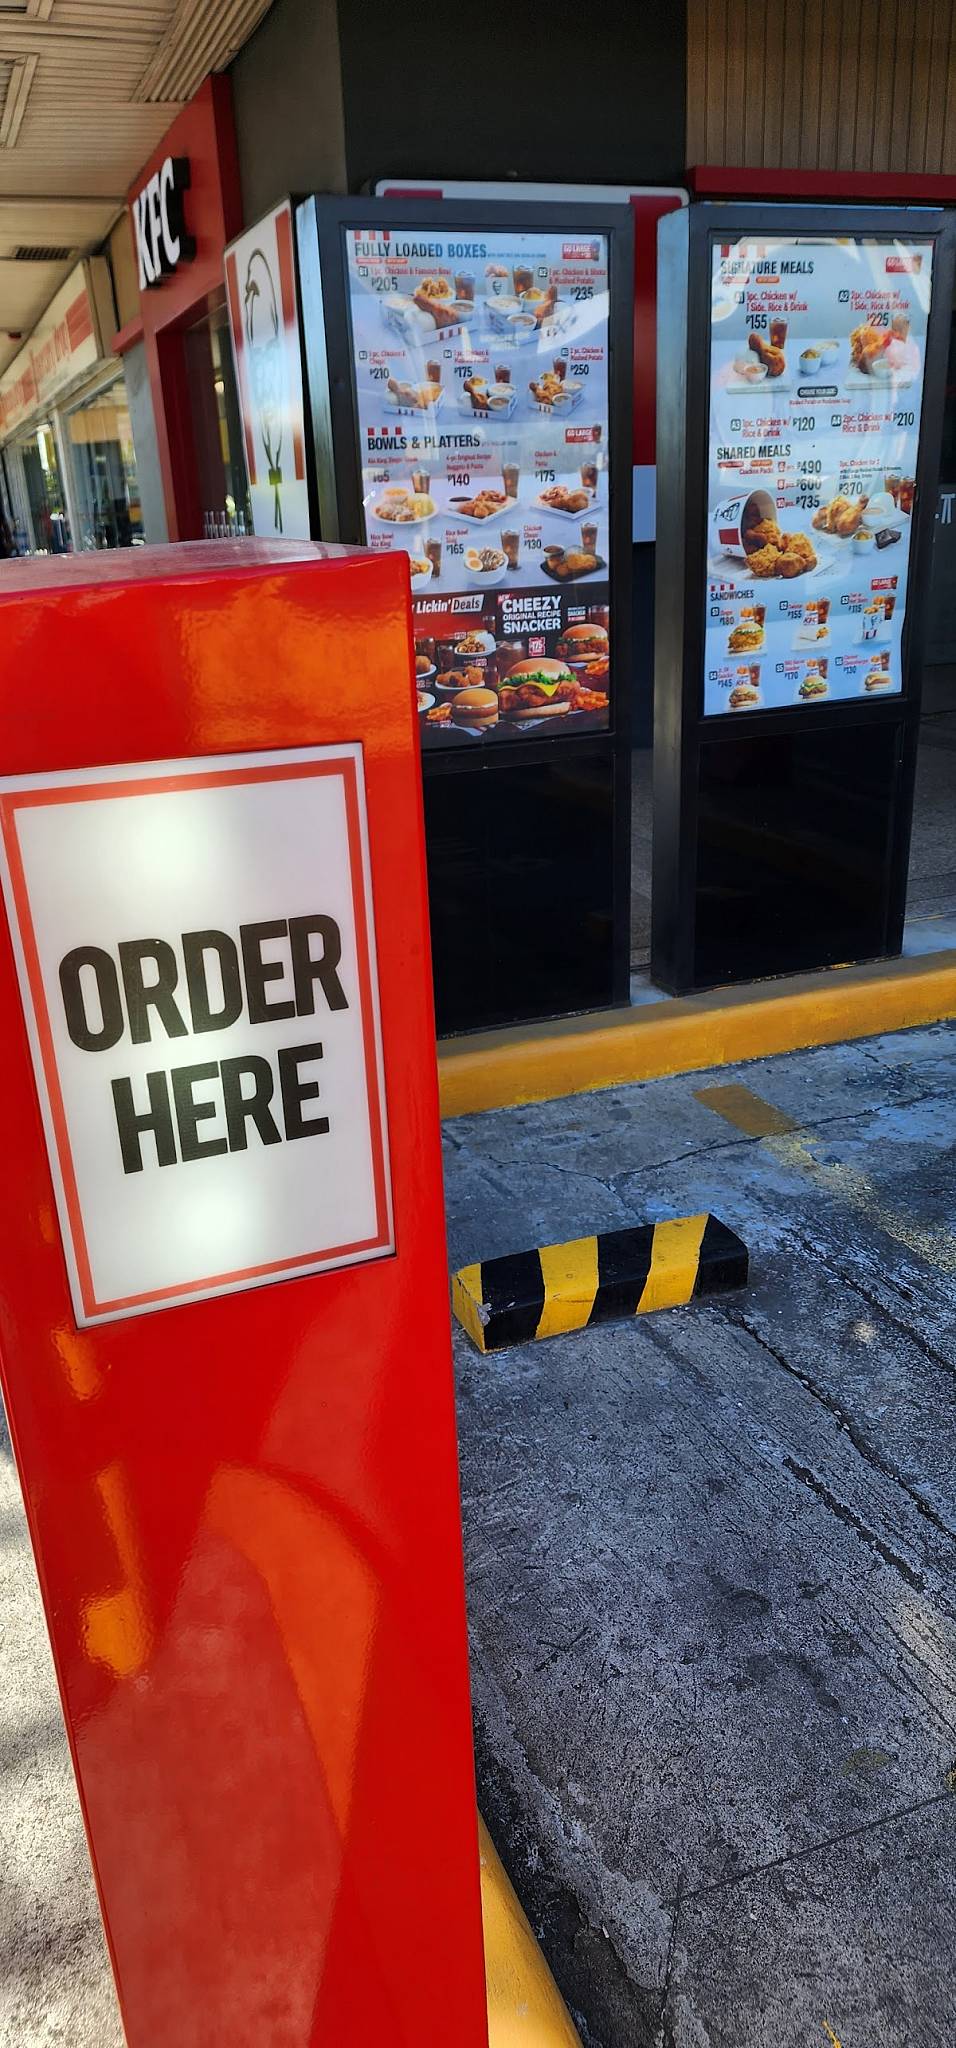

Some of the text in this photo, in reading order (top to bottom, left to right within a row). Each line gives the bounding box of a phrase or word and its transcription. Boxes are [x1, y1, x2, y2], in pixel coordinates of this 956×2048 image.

[133, 156, 181, 291] KFC
[355, 242, 486, 258] FULLY LOADED BOXES
[781, 261, 814, 274] MEALS
[761, 290, 787, 300] Chicken
[768, 301, 781, 311] Rice
[790, 301, 808, 311] Drink
[756, 417, 781, 426] Chicken
[858, 412, 882, 421] Chicken
[743, 429, 755, 437] Rice
[763, 428, 780, 437] Drink
[843, 424, 855, 432] Rice
[864, 423, 880, 432] Drink
[368, 436, 407, 450] BOWLS
[411, 436, 419, 448] &
[424, 434, 480, 449] PLATTERS
[717, 445, 791, 460] SHARED MEALS
[710, 589, 754, 601] SANDWICHES
[416, 599, 451, 614] Lickin'
[454, 597, 480, 610] Deals
[502, 595, 561, 613] CHEEZY
[503, 611, 536, 621] ORIGINAL
[537, 610, 561, 619] RECIPE
[504, 618, 560, 634] SNACKER
[59, 914, 349, 1052] ORDER
[111, 1042, 329, 1174] HERE
